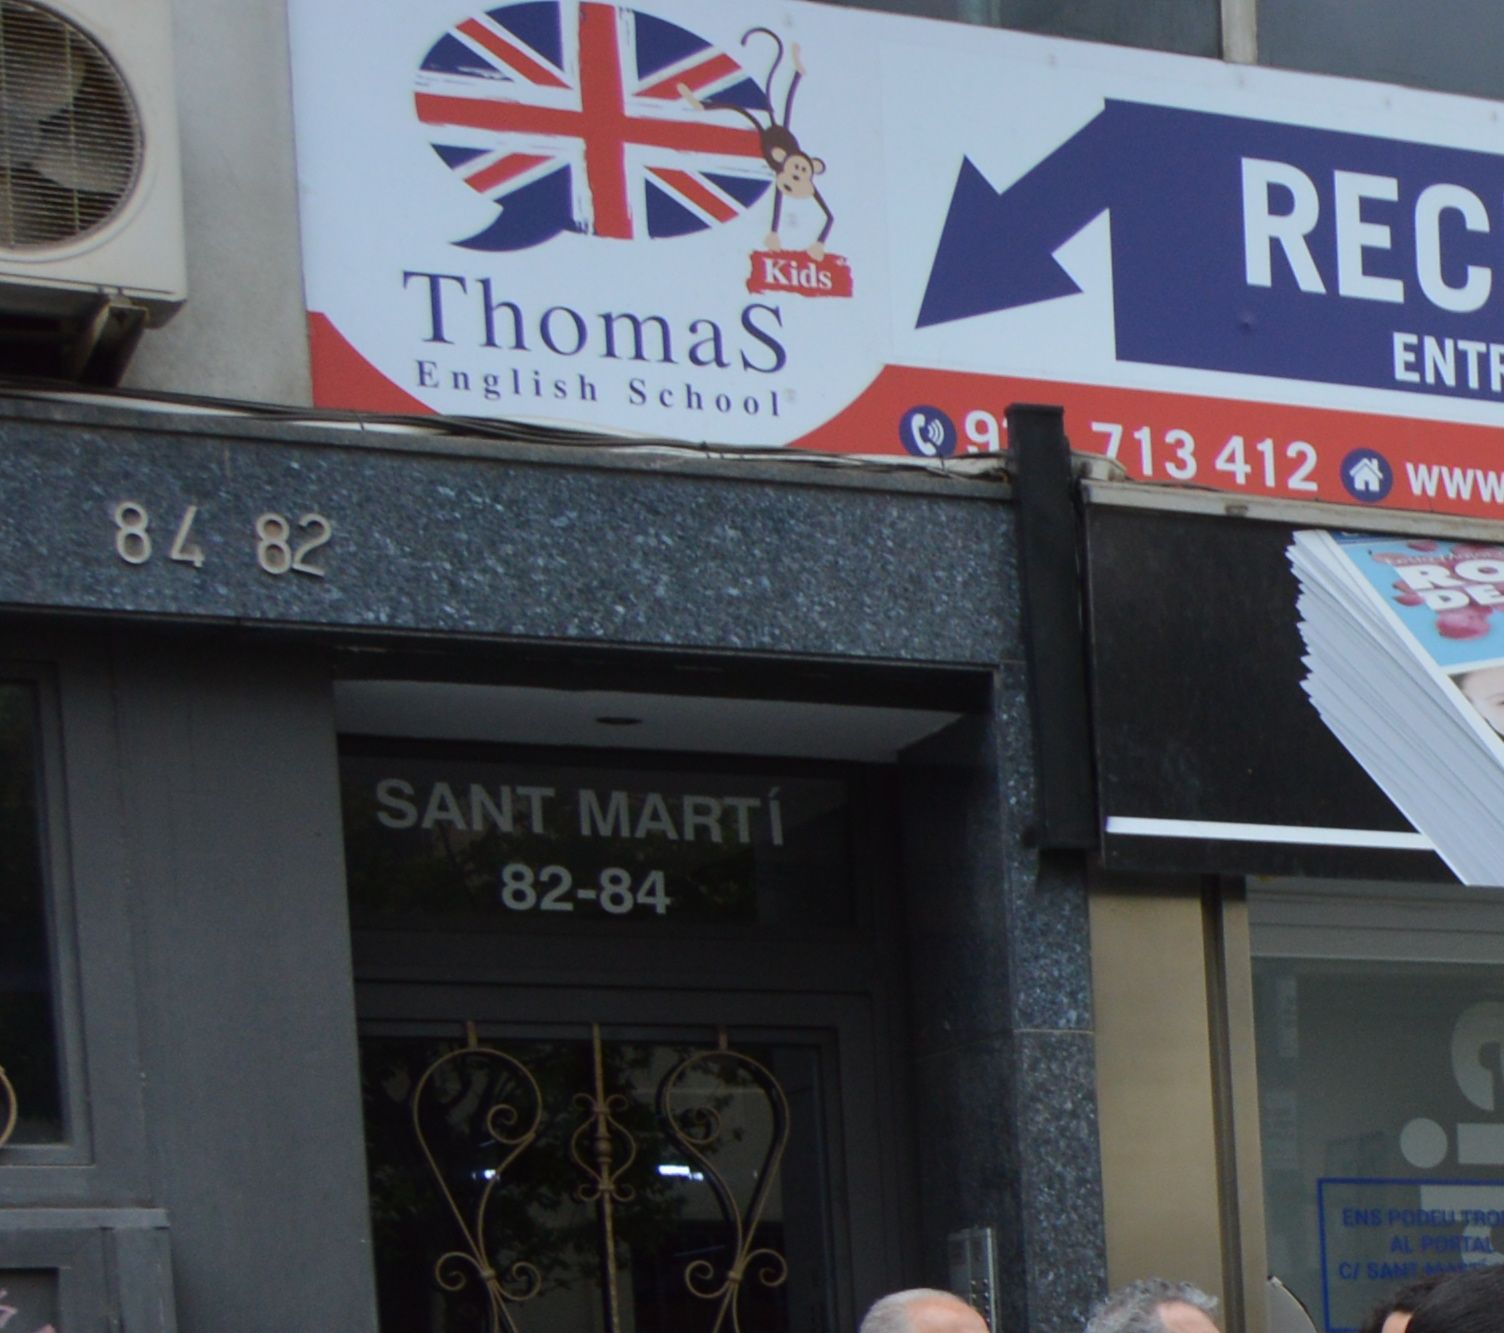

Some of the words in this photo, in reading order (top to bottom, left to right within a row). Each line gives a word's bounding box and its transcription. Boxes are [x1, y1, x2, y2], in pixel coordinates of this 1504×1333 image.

[763, 257, 834, 291] Kids
[402, 270, 788, 375] ThomaS
[415, 359, 599, 402] English
[628, 377, 781, 418] School
[1090, 420, 1199, 481] 713
[1214, 434, 1320, 493] 412
[114, 501, 206, 569] 84
[256, 512, 333, 578] 82
[375, 777, 556, 835] SANT
[577, 785, 784, 847] MARTÍ
[500, 862, 672, 915] 82-84
[1343, 1208, 1381, 1227] ENS
[1387, 1207, 1456, 1227] PODEU
[1390, 1235, 1413, 1254] AL
